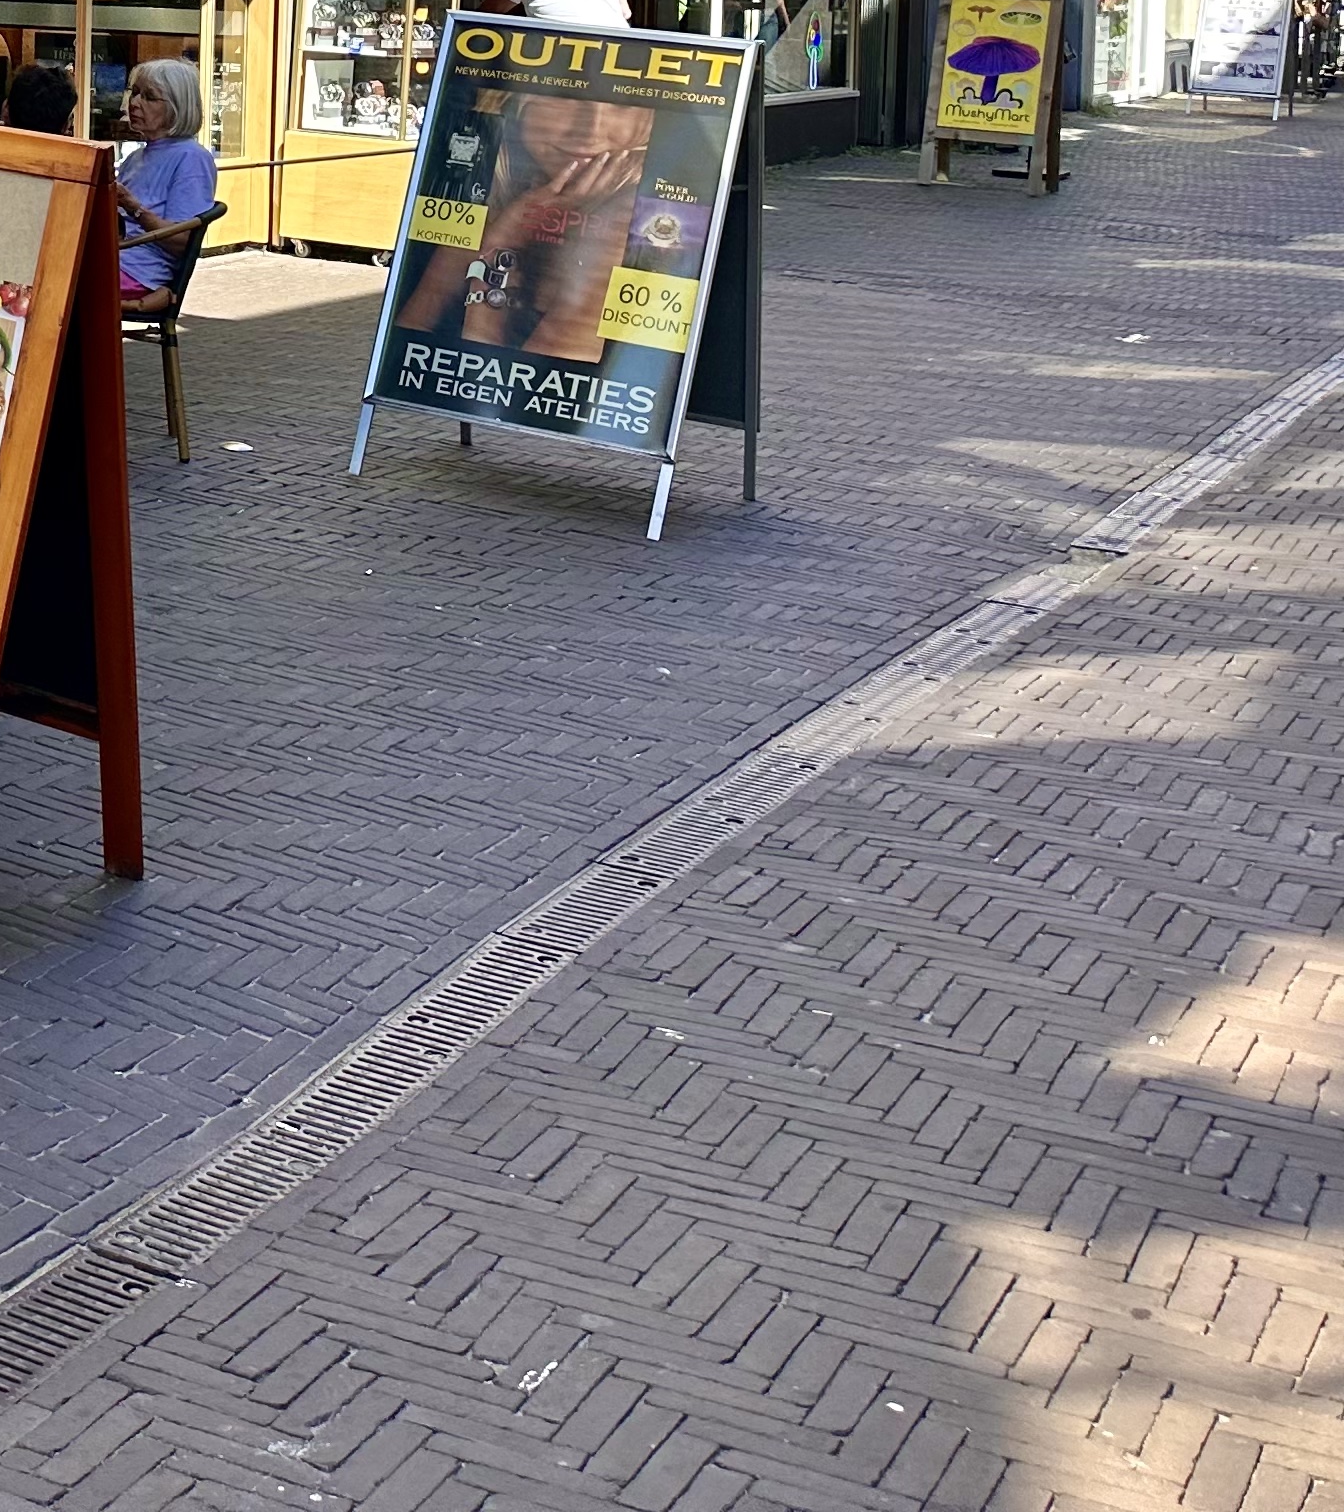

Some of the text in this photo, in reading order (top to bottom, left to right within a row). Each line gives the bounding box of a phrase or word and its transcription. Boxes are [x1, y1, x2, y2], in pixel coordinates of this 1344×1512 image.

[456, 28, 743, 88] OUTLET
[455, 65, 725, 106] NEW WATCHES & JEWELRY HIGHEST DISCOUNTS
[945, 104, 1030, 122] MushyMart
[422, 198, 475, 227] 80%
[416, 228, 471, 247] KORTING
[618, 282, 682, 314] 60 %
[602, 306, 691, 337] DISCOUNT
[402, 342, 656, 414] REPARATIES
[399, 369, 650, 435] IN EIGEN ATELIERS
